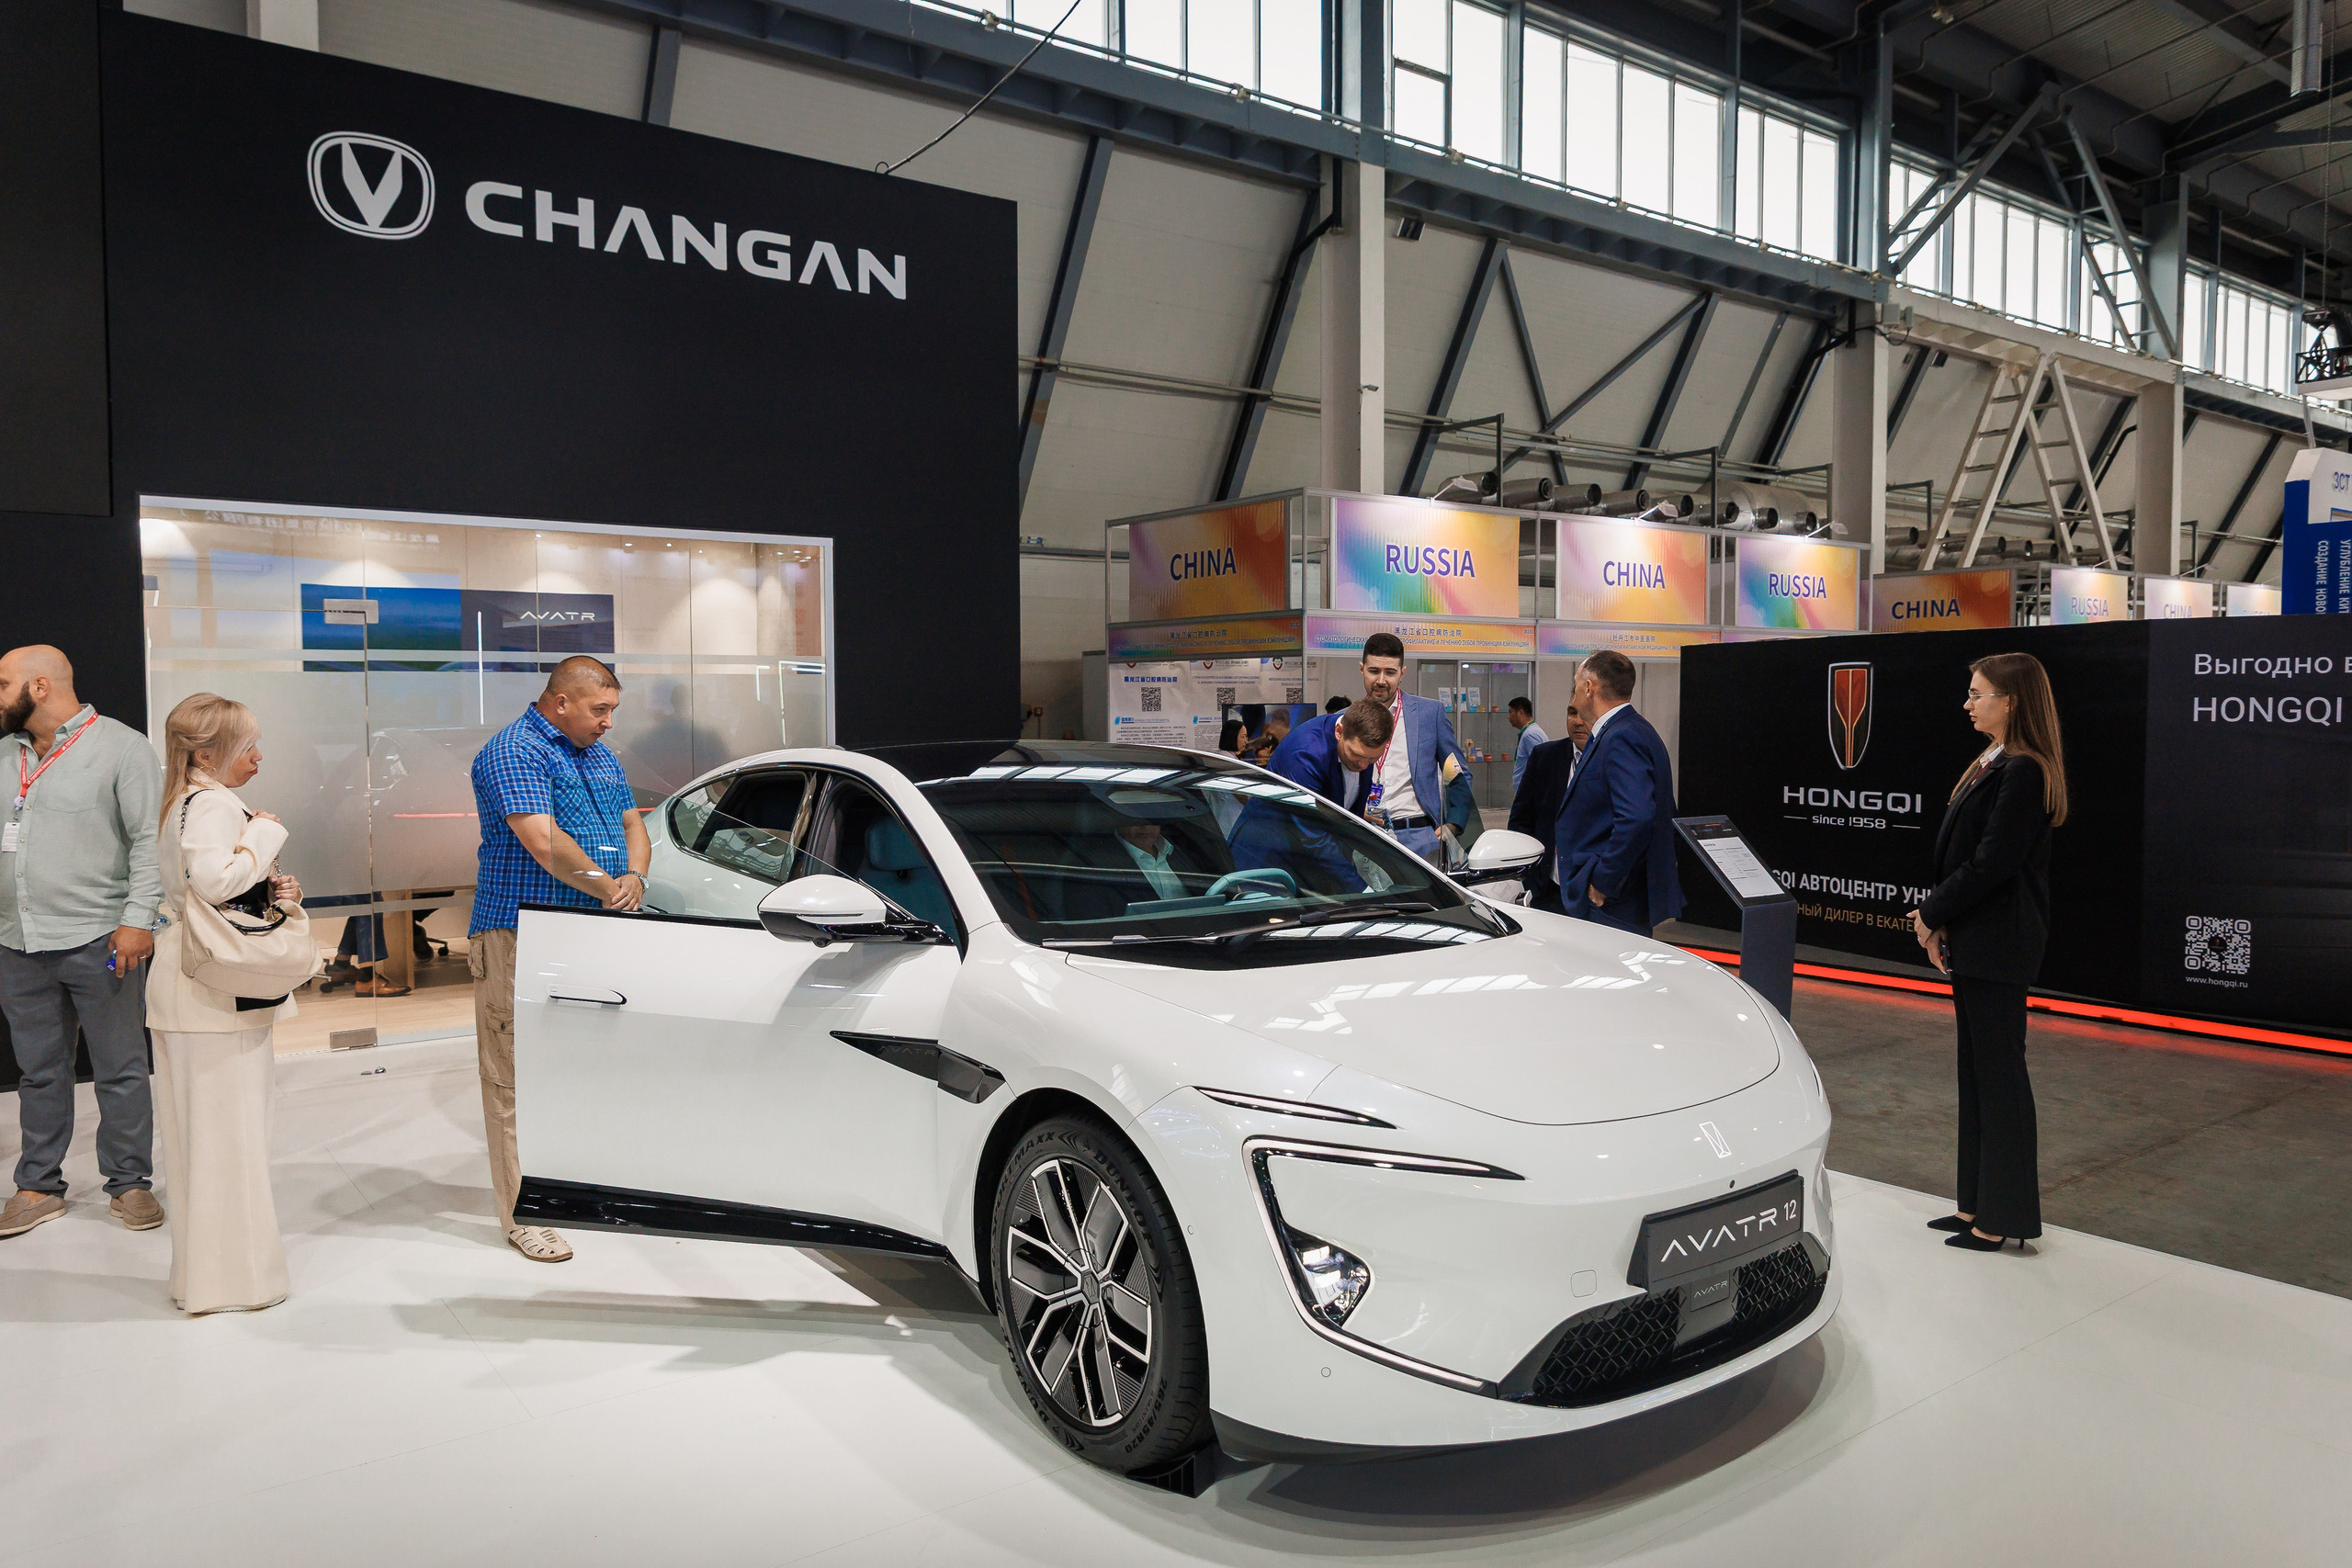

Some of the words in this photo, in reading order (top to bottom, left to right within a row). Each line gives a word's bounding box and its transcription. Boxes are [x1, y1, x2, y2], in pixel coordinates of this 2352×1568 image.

[466, 181, 907, 299] CHANGAN
[1170, 547, 1238, 581] CHINA
[1385, 544, 1476, 578] RUSSIA
[1603, 560, 1666, 589] CHINA
[2314, 540, 2329, 585] СОЗДАНИЕ
[1769, 573, 1827, 599] RUSSIA
[520, 611, 595, 621] AVATR
[1891, 599, 1961, 619] CHINA
[2071, 597, 2109, 616] RUSSIA
[1395, 626, 1462, 637] 黑龙江省口腔病防治院
[2195, 653, 2334, 678] Выгодно
[2193, 696, 2343, 727] HONGQI
[1783, 786, 1922, 814] HONGQI
[1812, 815, 1845, 826] since
[1849, 817, 1886, 829] 1958
[1799, 873, 1897, 901] АВТОЦЕНТР
[1824, 907, 1864, 925] ДИЛЕР
[1867, 914, 1874, 926] В
[2186, 976, 2248, 988] www.hongqi.ru
[1014, 1131, 1056, 1165] MAXX
[1093, 1152, 1155, 1250] DUNLOP
[1660, 1207, 1778, 1263] AVATR
[1783, 1199, 1797, 1221] 12
[1693, 1280, 1728, 1299] AVATR
[1125, 1376, 1168, 1454] 265/45R20
